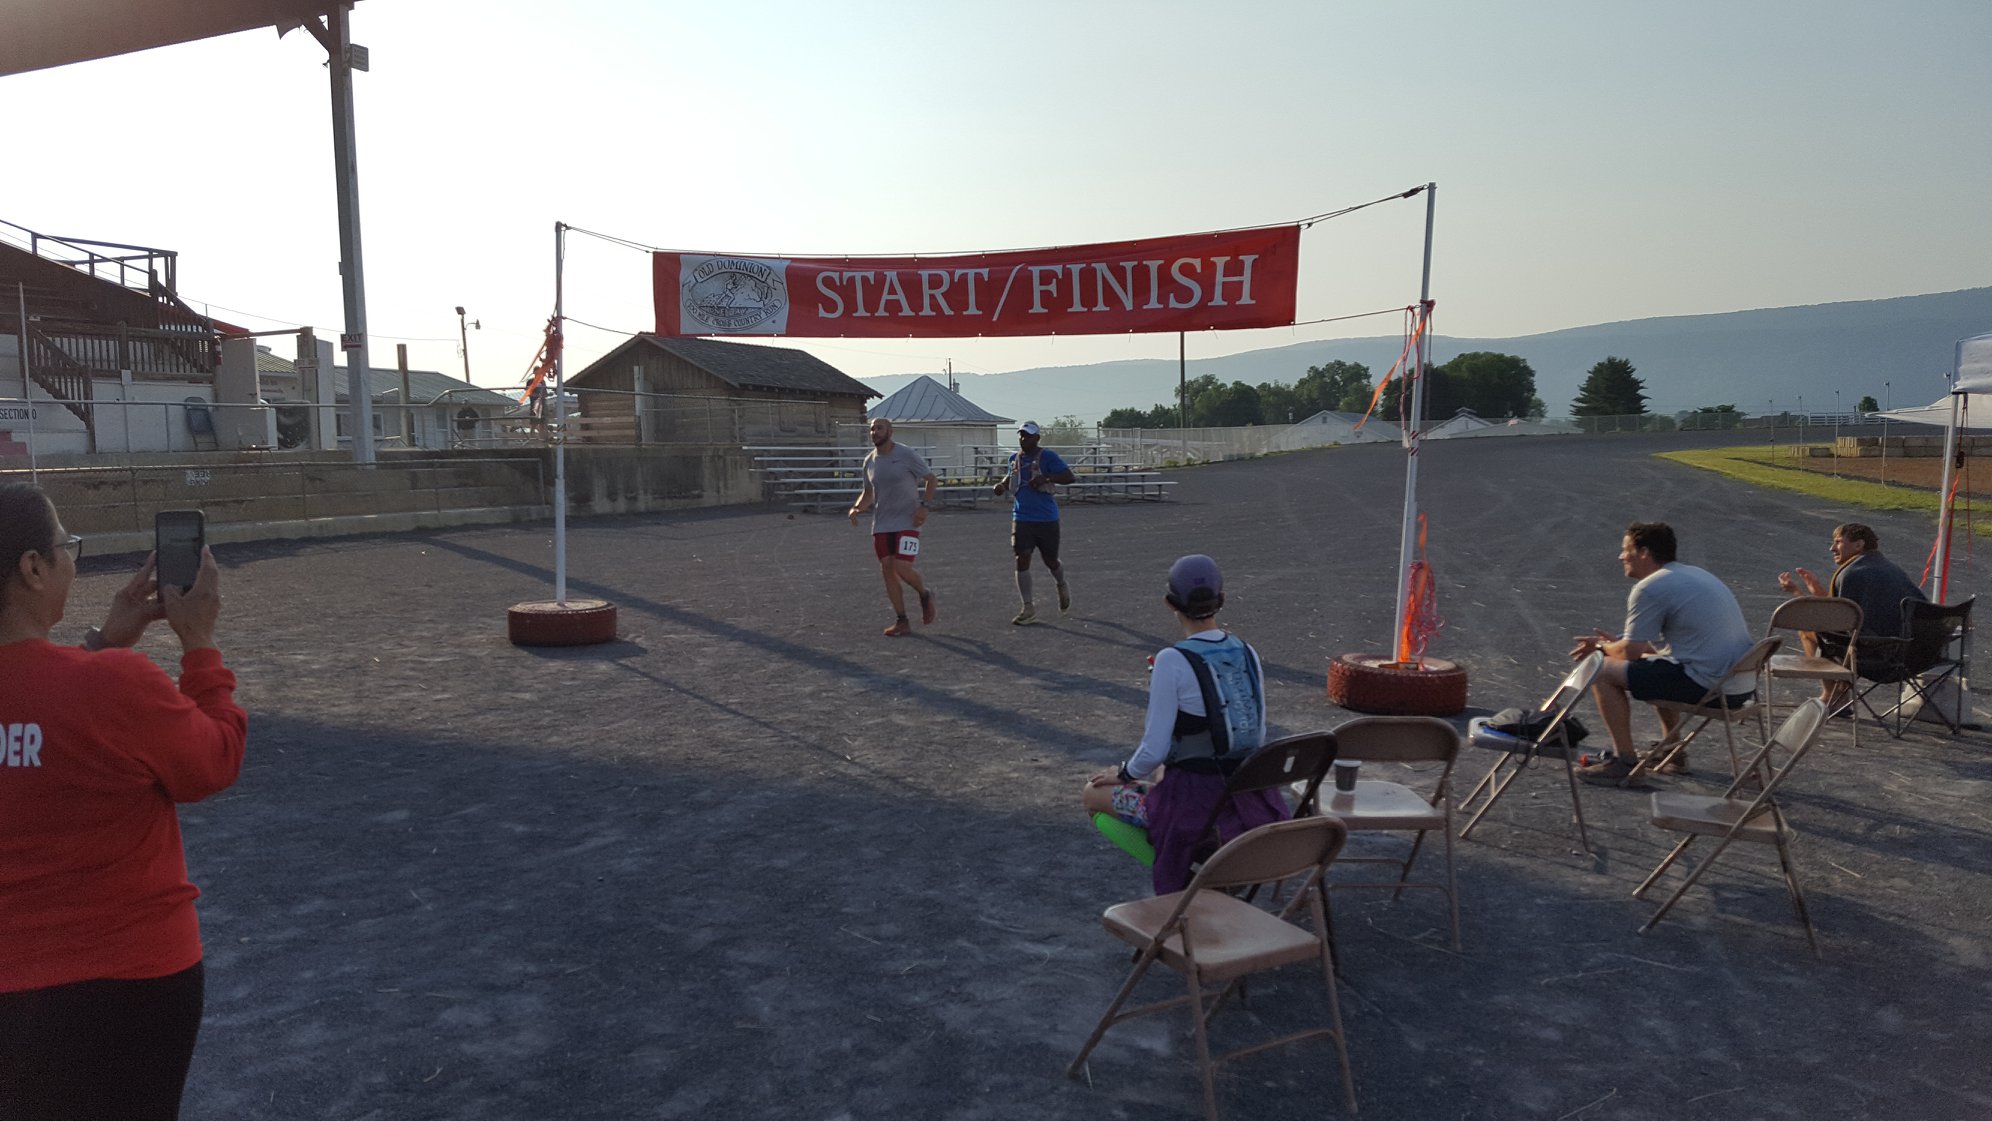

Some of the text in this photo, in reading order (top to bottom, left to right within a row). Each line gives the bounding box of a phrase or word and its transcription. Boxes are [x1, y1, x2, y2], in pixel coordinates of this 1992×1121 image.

[698, 259, 766, 280] OLD DOMINION
[815, 254, 1260, 322] START/FINISH
[733, 312, 763, 328] COUNTRY
[763, 302, 779, 317] RUN
[341, 333, 363, 342] EXIT
